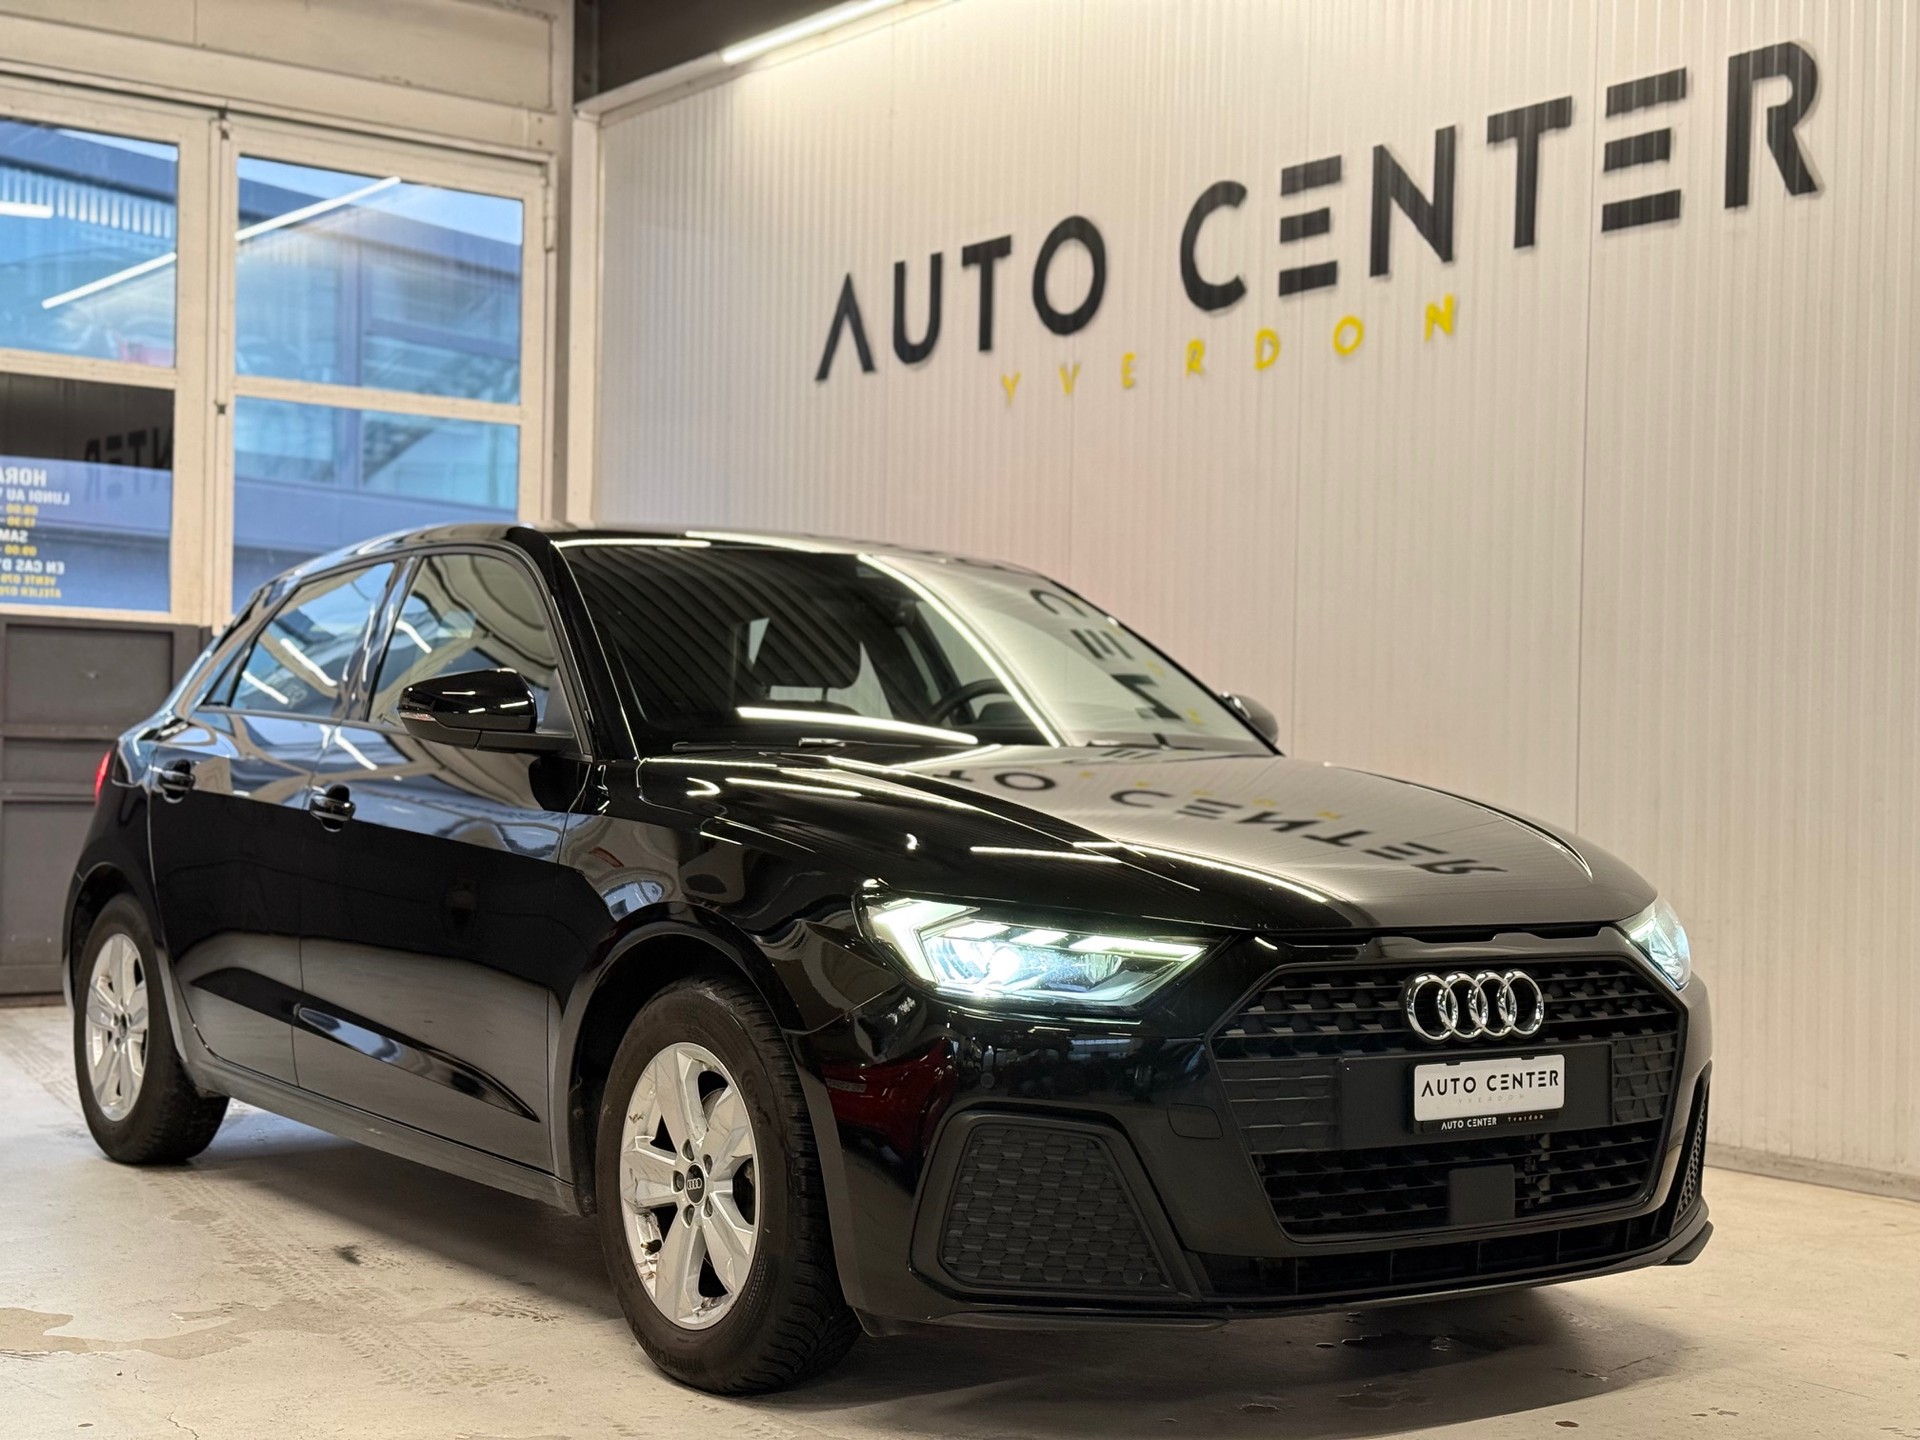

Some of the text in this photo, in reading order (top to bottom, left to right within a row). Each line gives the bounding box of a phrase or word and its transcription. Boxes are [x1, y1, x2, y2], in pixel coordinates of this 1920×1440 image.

[815, 41, 1821, 382] AUTO CENTER
[1002, 294, 1456, 402] YVERDON
[1421, 1070, 1559, 1098] AUTO CENTER
[1458, 1094, 1525, 1105] YVERDON
[1441, 1120, 1464, 1131] AUTO
[1466, 1116, 1498, 1128] CENTER
